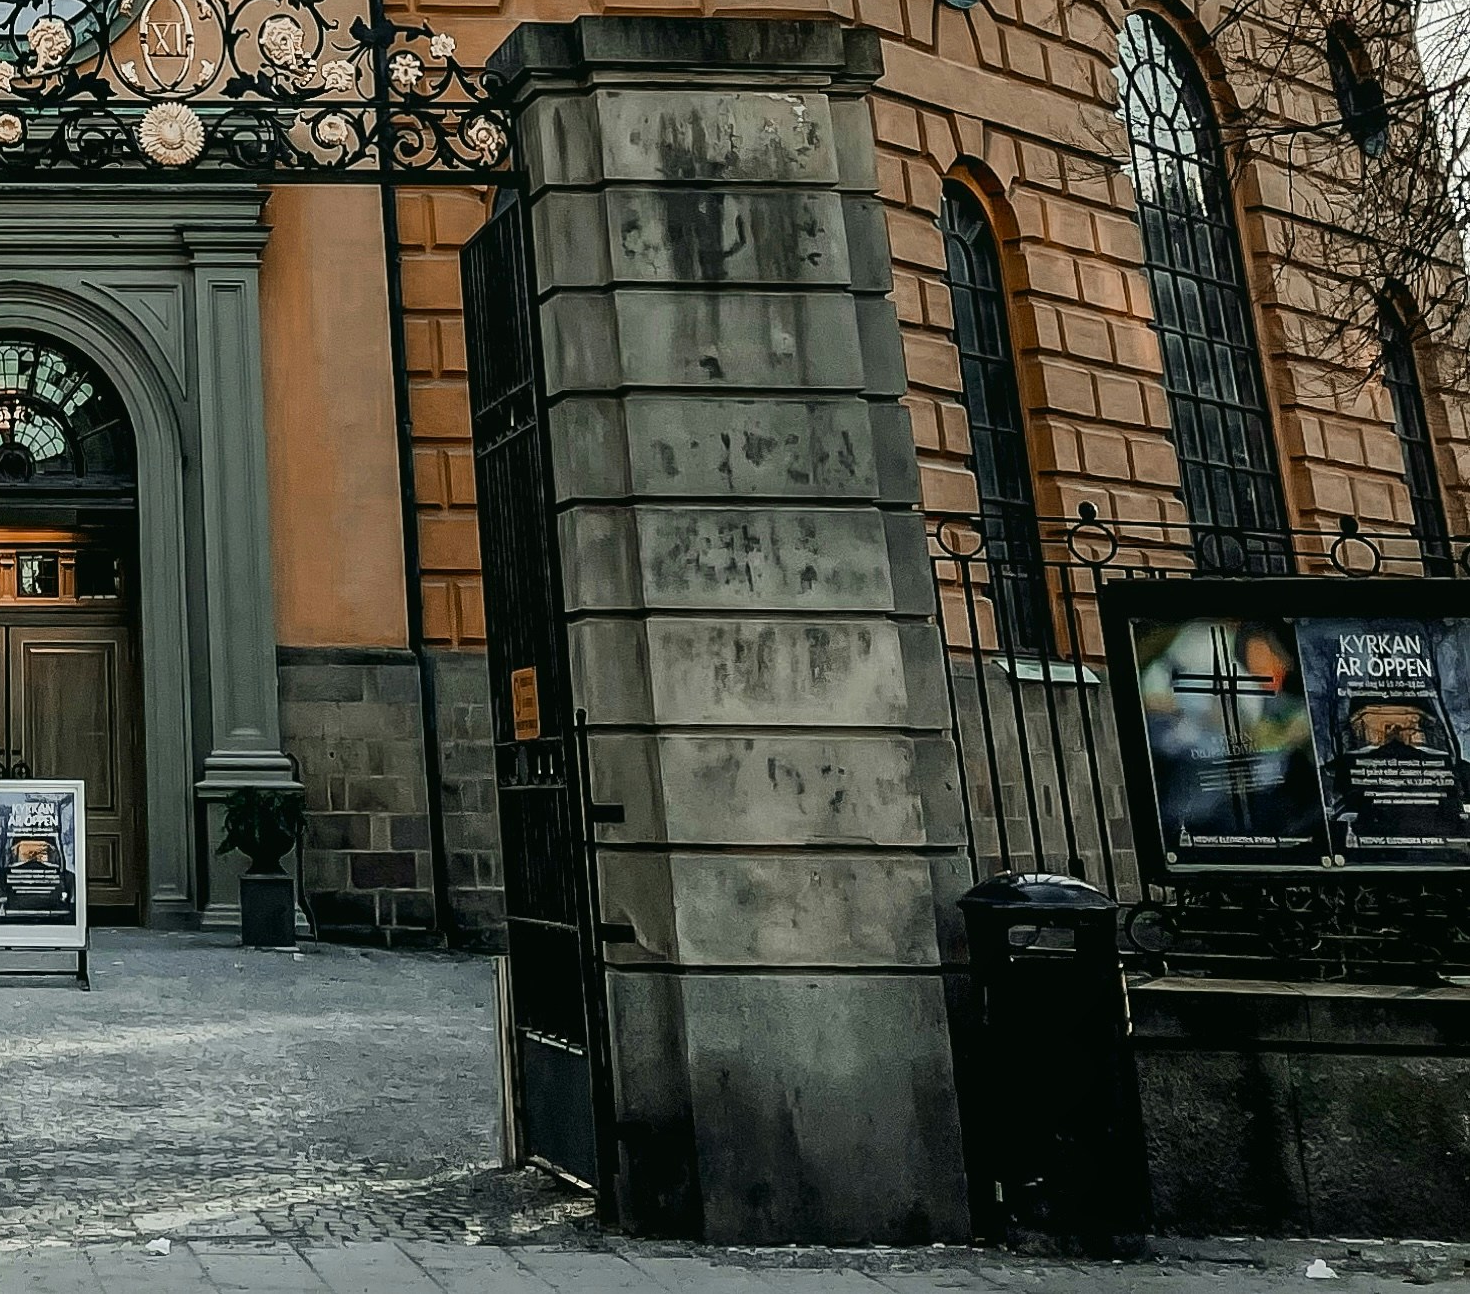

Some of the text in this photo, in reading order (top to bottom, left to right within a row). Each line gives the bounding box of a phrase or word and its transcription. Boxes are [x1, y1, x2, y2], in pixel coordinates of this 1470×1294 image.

[148, 22, 187, 56] XI
[1339, 634, 1421, 654] KYRKAN
[1336, 653, 1432, 678] ÄR ÖPPEN
